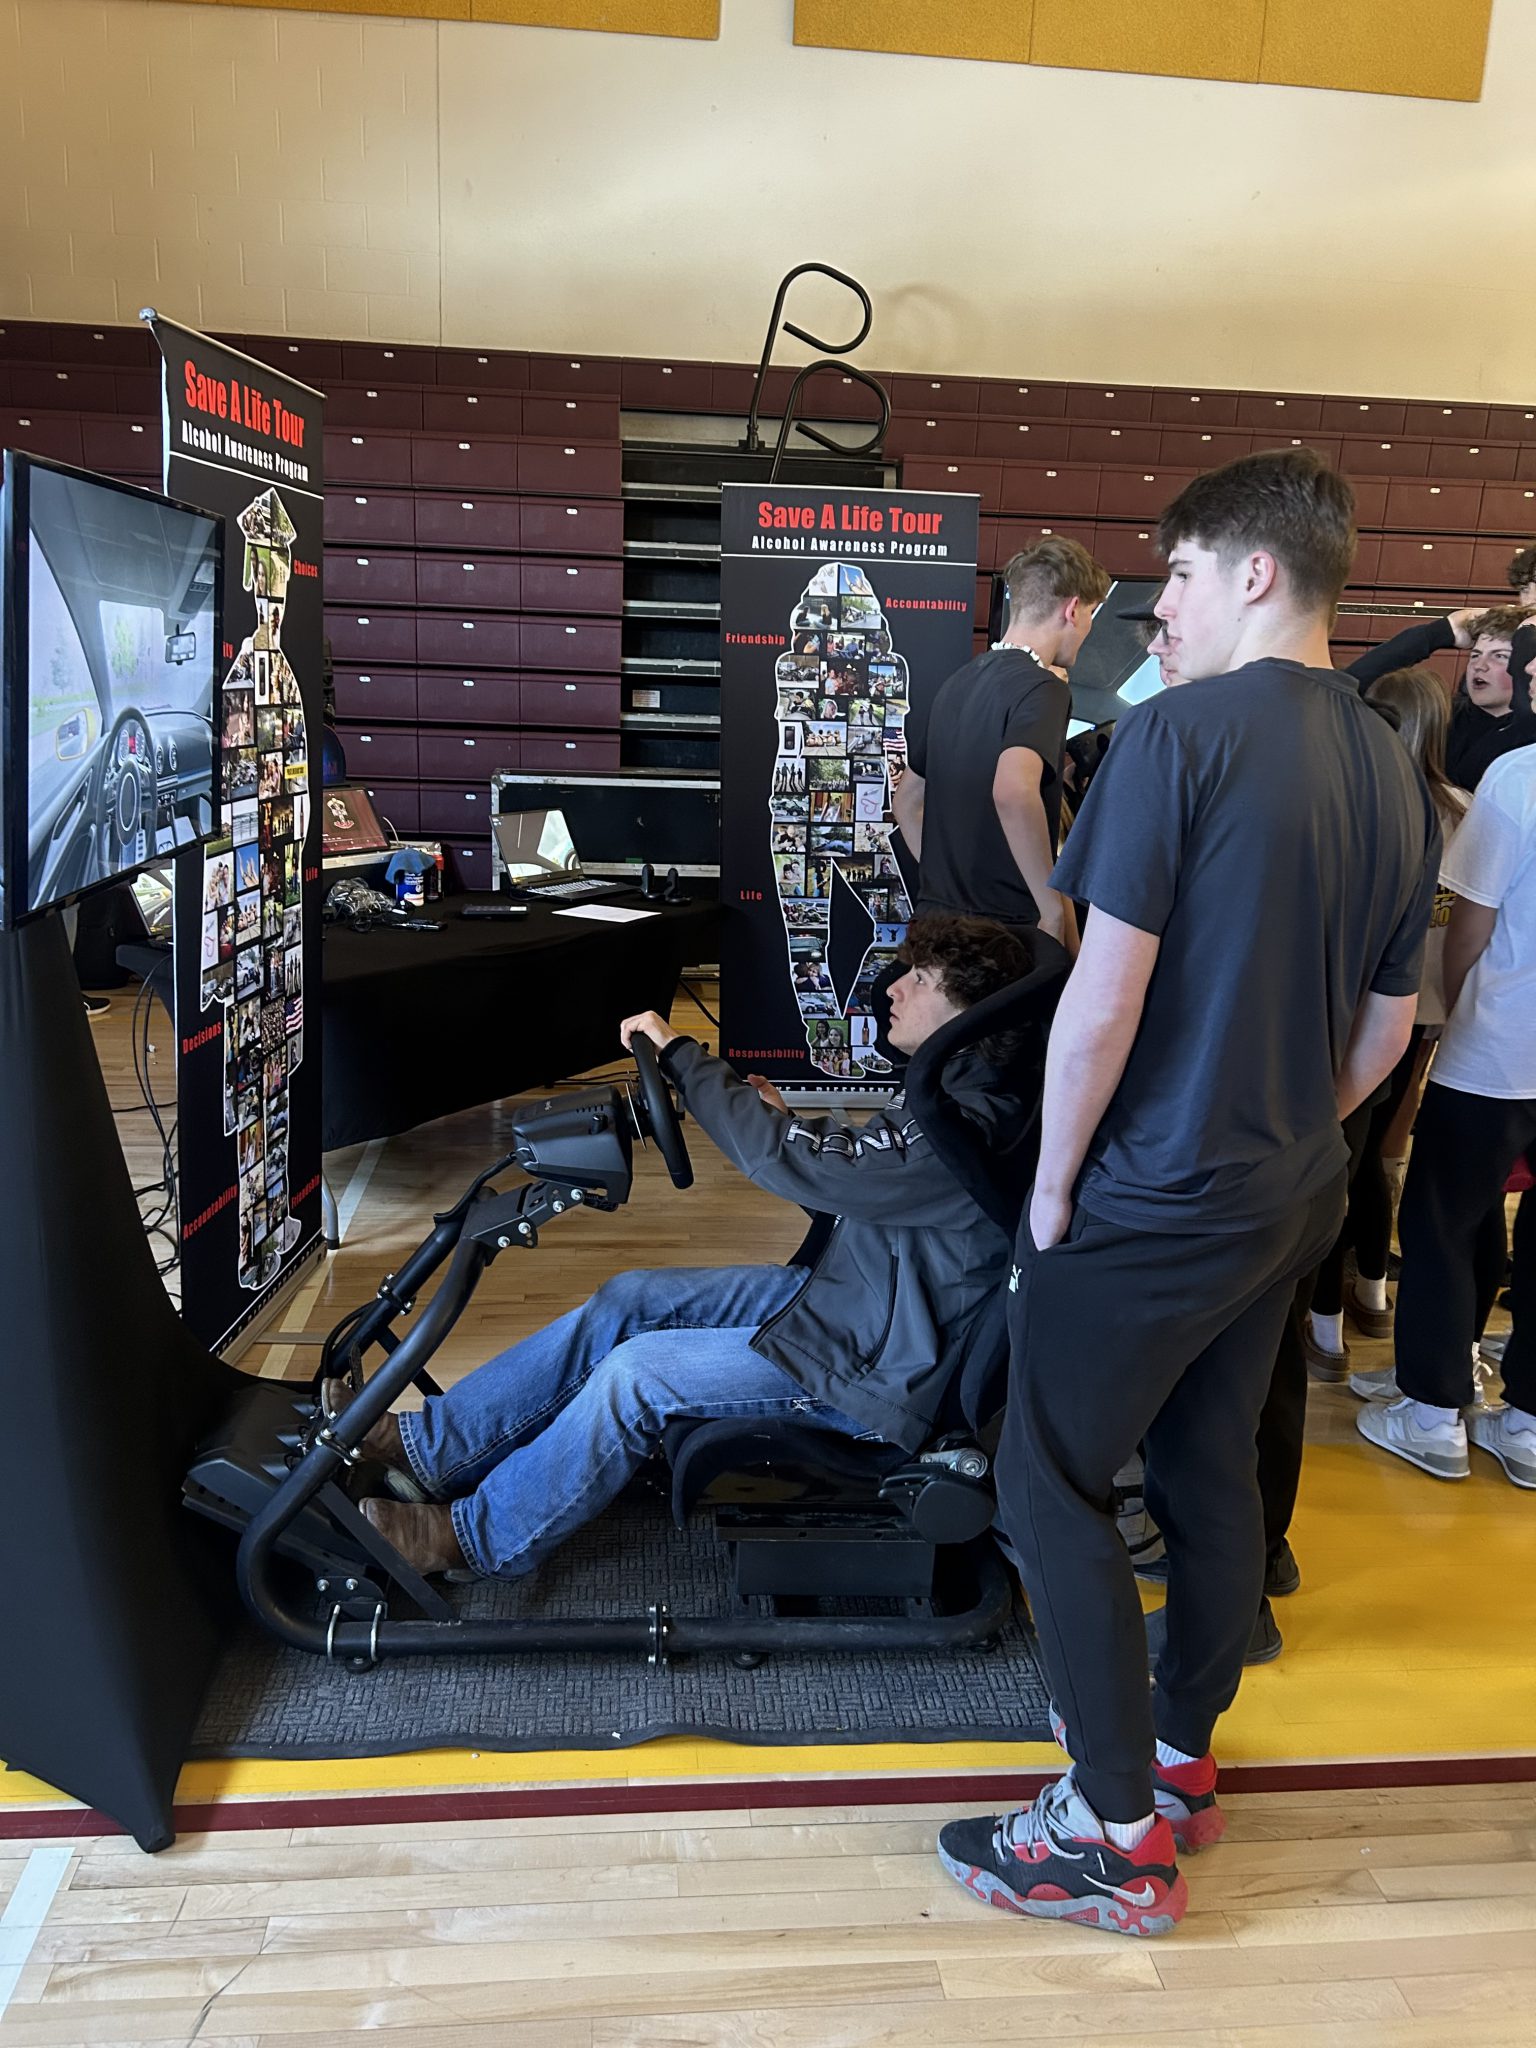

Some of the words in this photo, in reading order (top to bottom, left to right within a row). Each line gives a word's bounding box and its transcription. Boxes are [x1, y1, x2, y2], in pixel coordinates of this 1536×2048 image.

[184, 360, 227, 419] Save
[230, 379, 242, 425] A
[243, 385, 271, 436] Life
[273, 398, 305, 448] Tour
[181, 419, 222, 455] Alcohol
[224, 434, 273, 471] Awareness
[275, 452, 309, 483] Program
[758, 501, 816, 529] Save
[820, 504, 836, 530] A
[841, 505, 884, 532] Life
[889, 507, 943, 534] Tour
[751, 535, 805, 551] Alcohol
[810, 537, 885, 554] Awareness
[890, 541, 948, 557] Program
[293, 559, 318, 578] Choices
[885, 597, 967, 612] Accountability
[725, 632, 786, 646] Friendship
[305, 866, 318, 882] Life
[740, 889, 763, 901] Life
[182, 1021, 222, 1055] Decisions
[728, 1047, 805, 1060] Responsibility
[183, 1183, 238, 1240] Accountability
